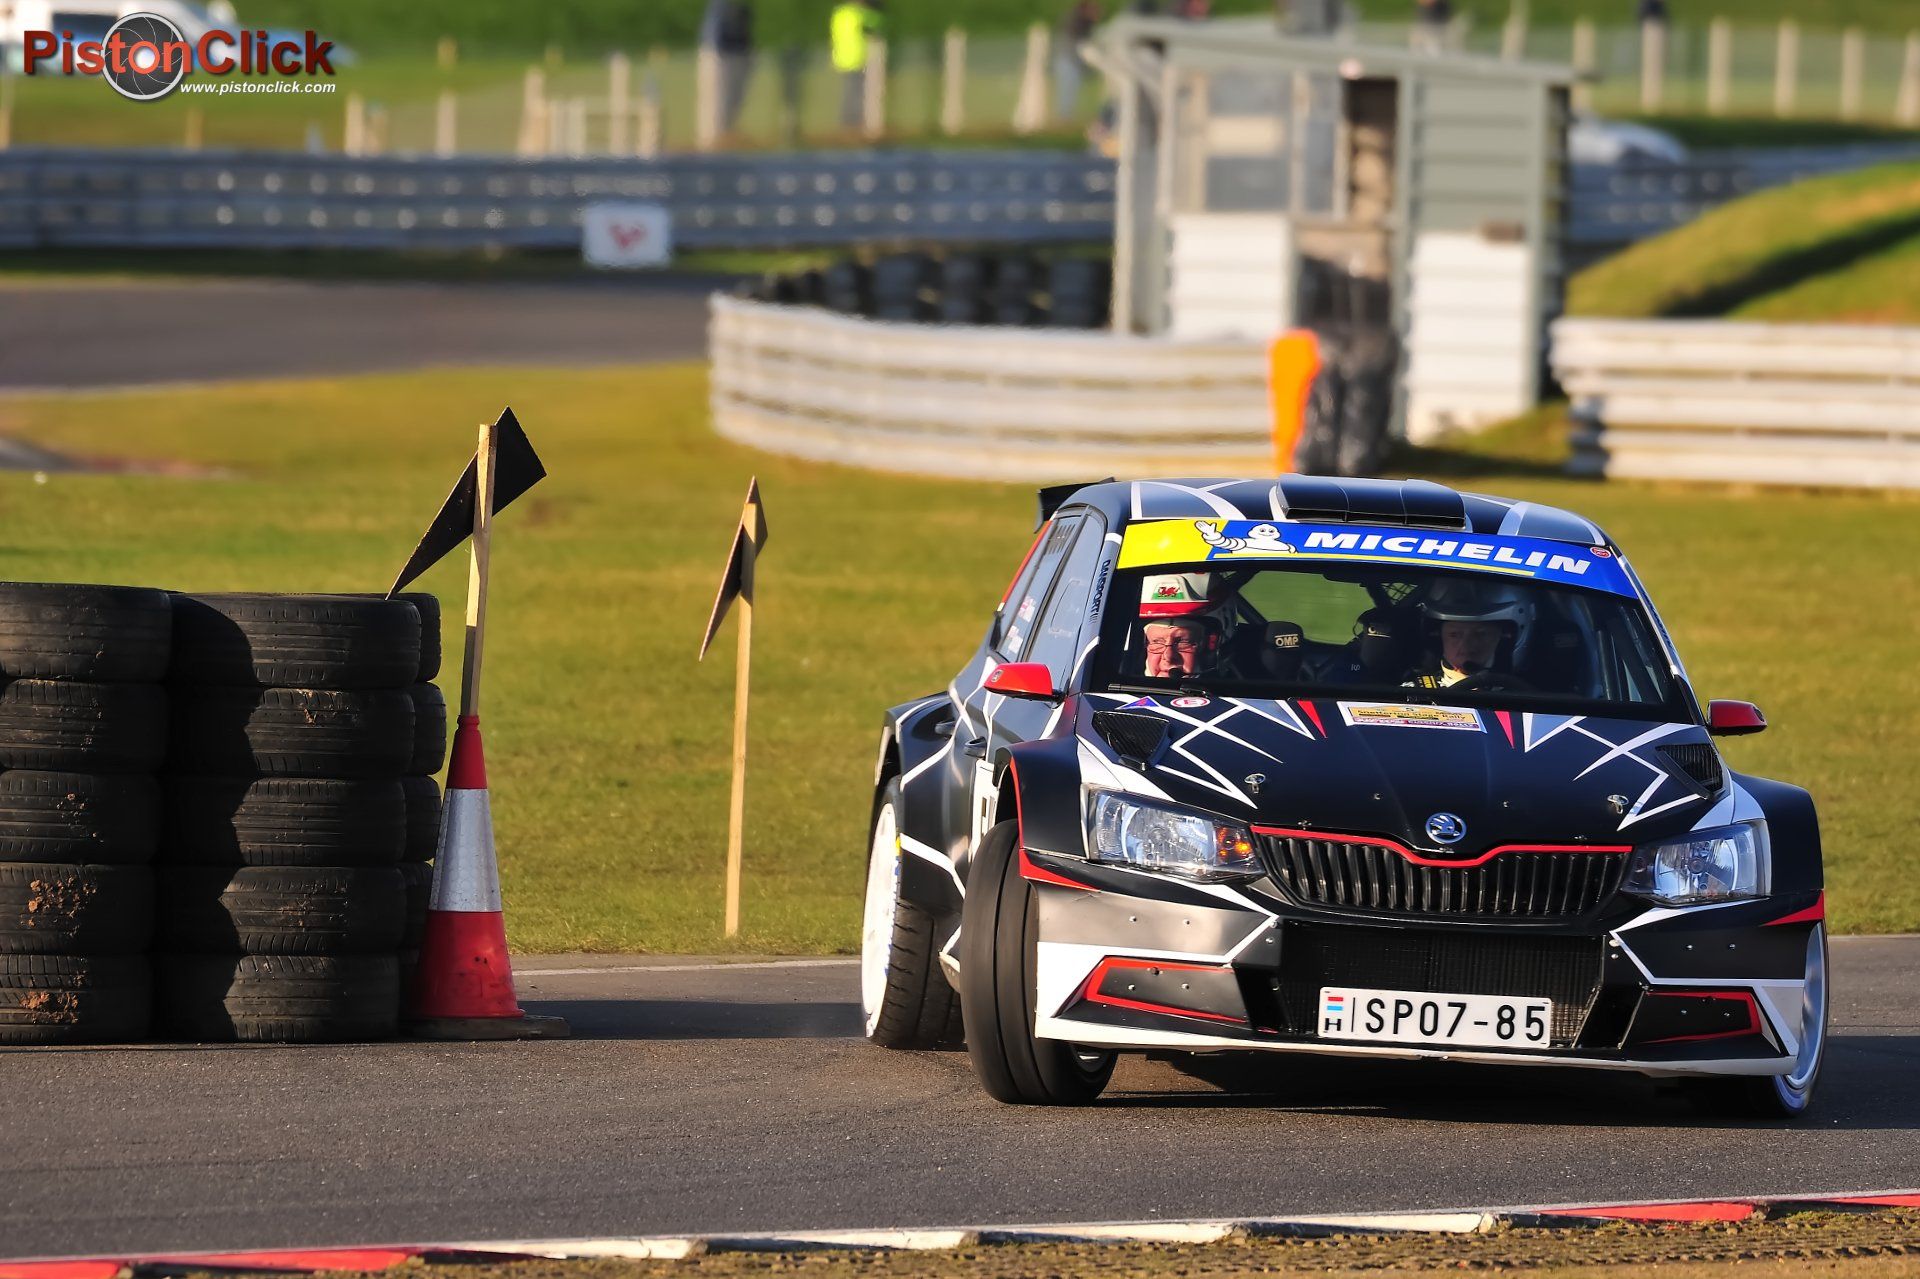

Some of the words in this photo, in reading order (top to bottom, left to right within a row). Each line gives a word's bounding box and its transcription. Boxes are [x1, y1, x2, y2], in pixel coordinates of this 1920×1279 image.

[1304, 532, 1592, 575] MICHELIN
[1275, 636, 1299, 647] OMP
[1325, 1018, 1341, 1031] H
[1365, 998, 1546, 1042] SP07-85
